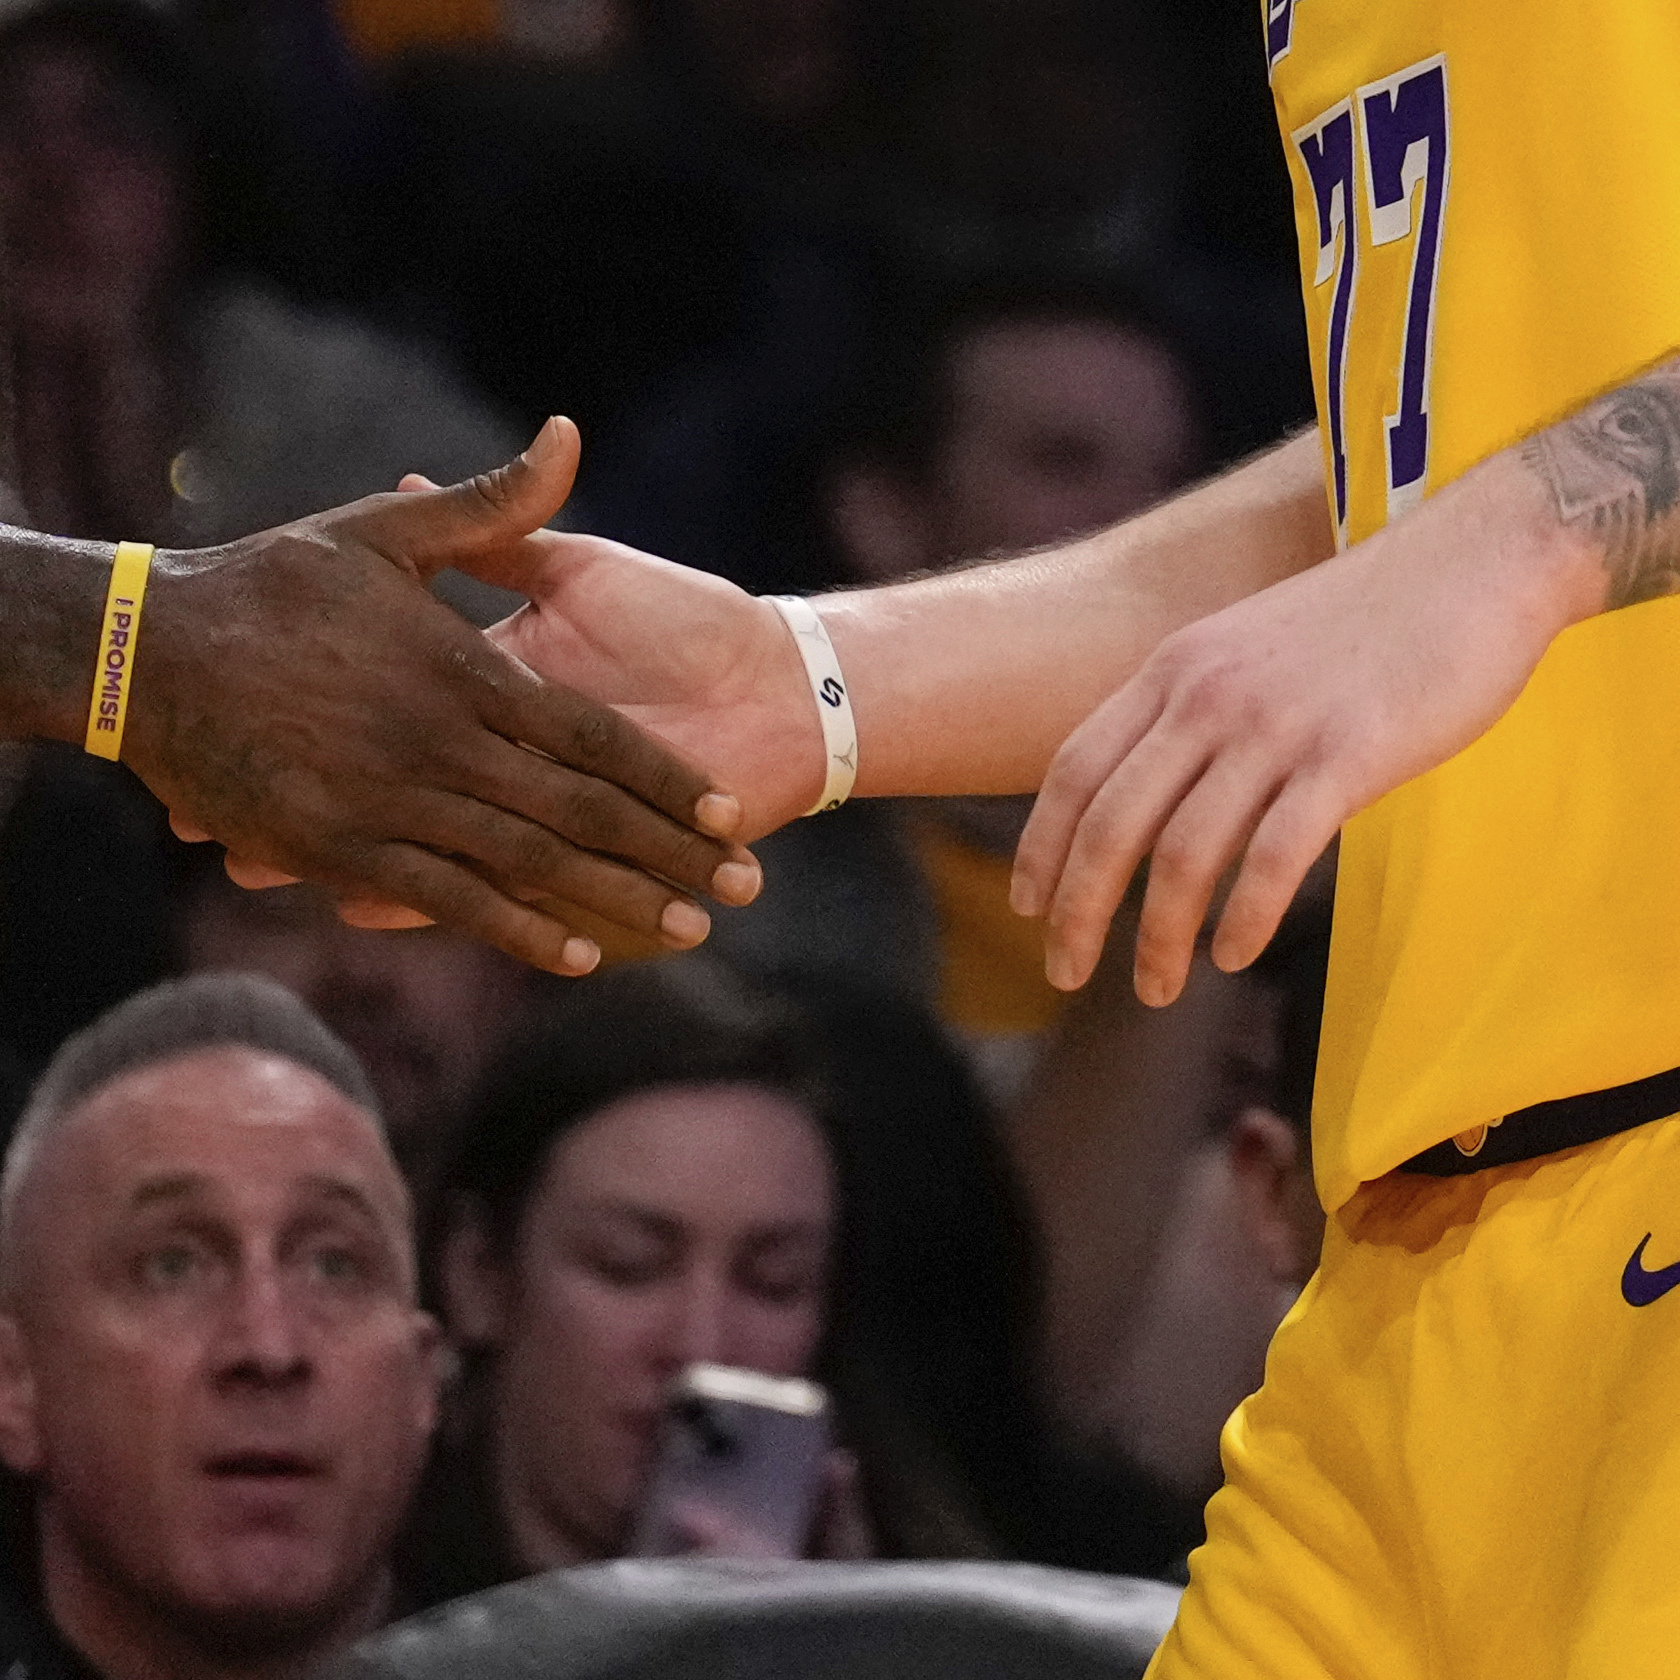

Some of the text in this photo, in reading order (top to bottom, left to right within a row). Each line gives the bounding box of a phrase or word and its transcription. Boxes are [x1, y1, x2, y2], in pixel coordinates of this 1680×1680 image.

[1292, 52, 1451, 555] 77
[95, 597, 134, 733] I PROMISE
